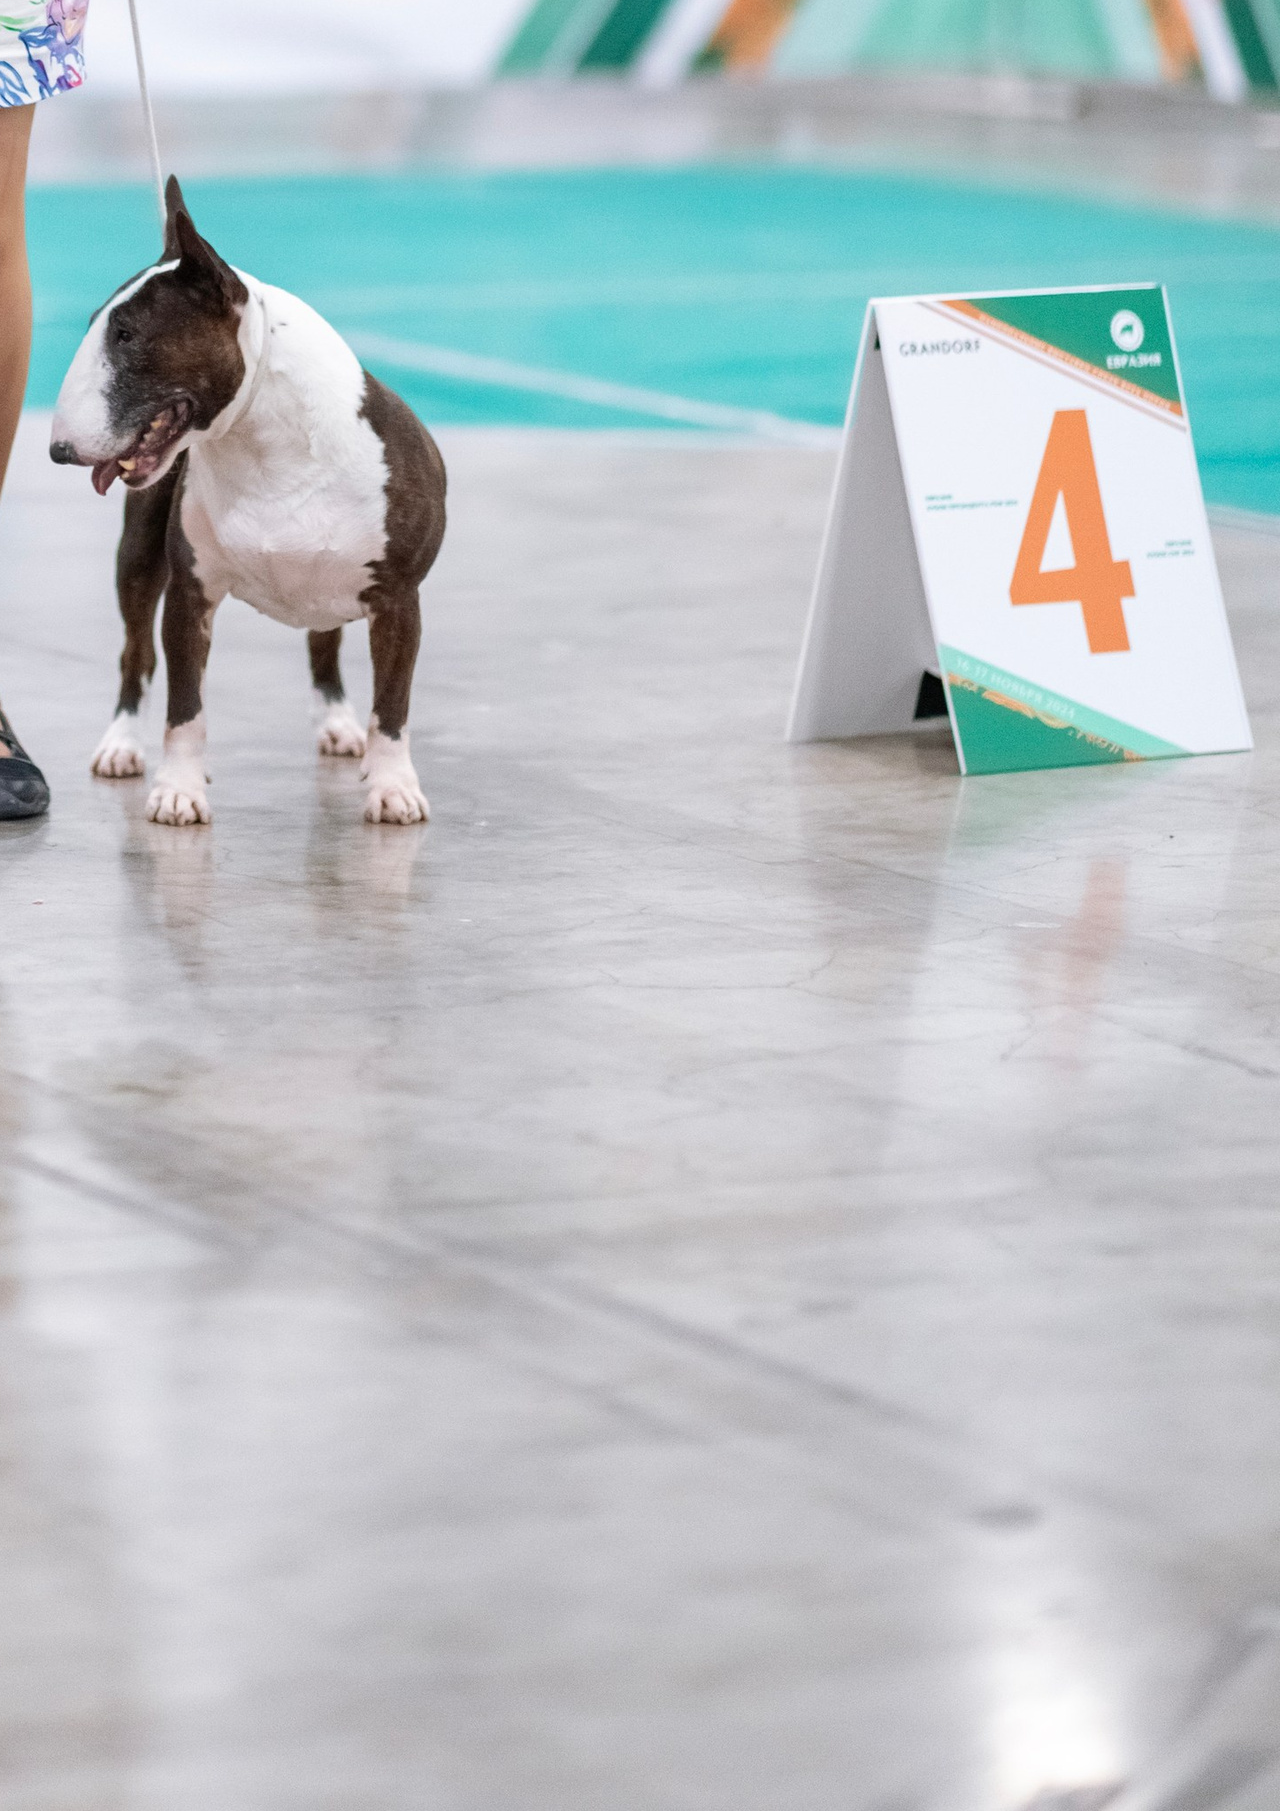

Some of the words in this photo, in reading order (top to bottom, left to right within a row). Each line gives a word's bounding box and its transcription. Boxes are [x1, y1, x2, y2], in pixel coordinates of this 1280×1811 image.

[899, 339, 980, 357] GRANDORF
[1106, 353, 1161, 369] ЕВРАЗИЯ
[1009, 409, 1136, 654] 4
